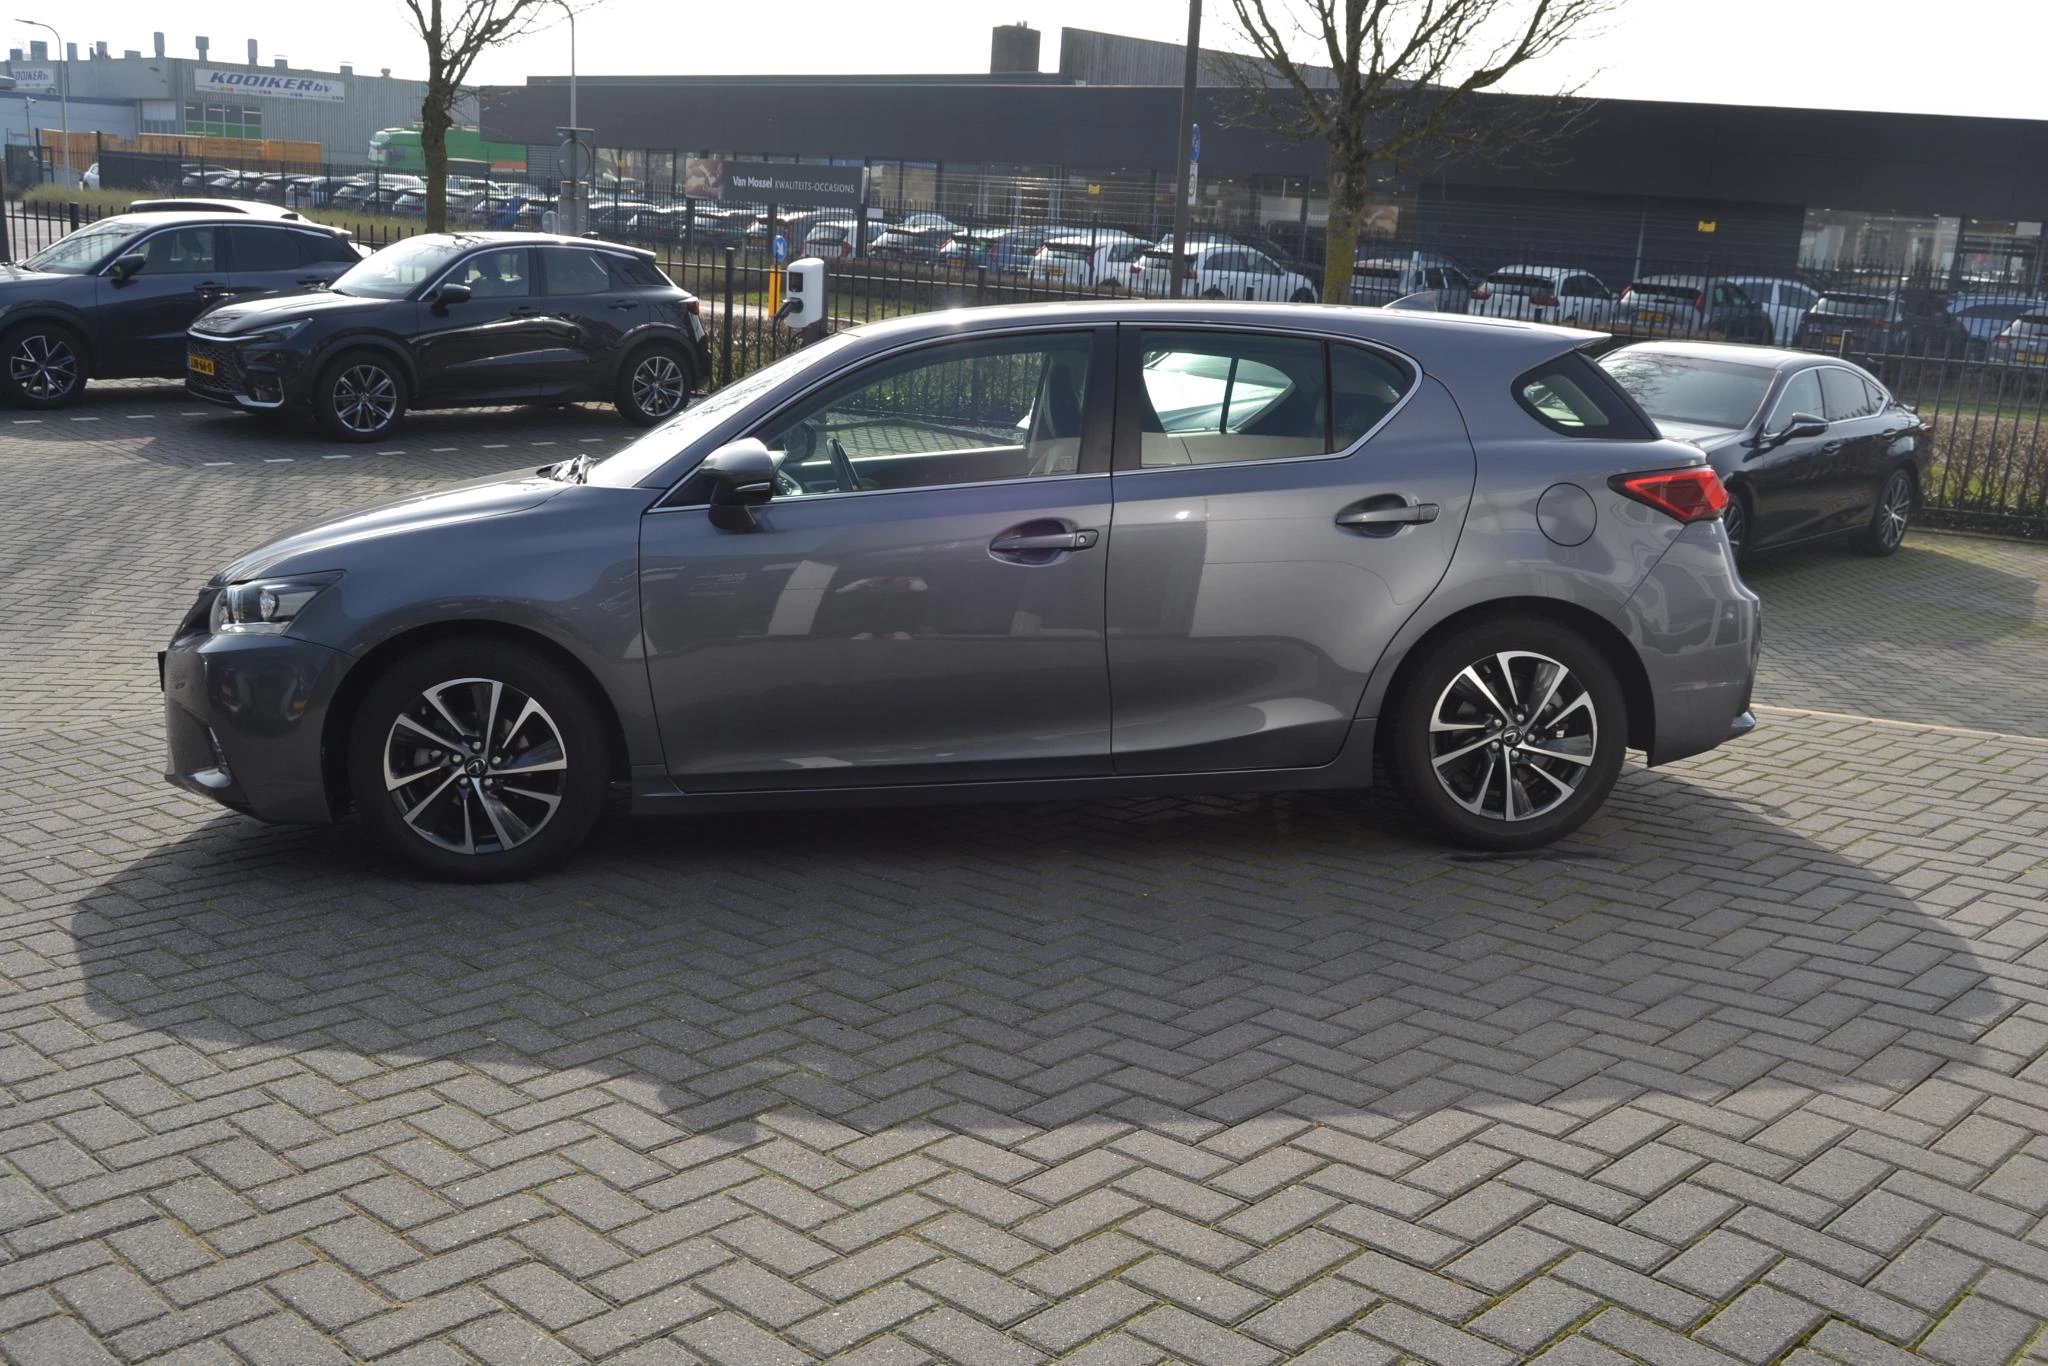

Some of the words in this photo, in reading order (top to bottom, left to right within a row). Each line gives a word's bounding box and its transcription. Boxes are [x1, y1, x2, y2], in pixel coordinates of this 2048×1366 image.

[209, 71, 313, 92] KOOIKER
[732, 175, 747, 187] Van
[747, 176, 773, 189] Mossel
[774, 180, 855, 194] KWALITEITS-OCCASIONS
